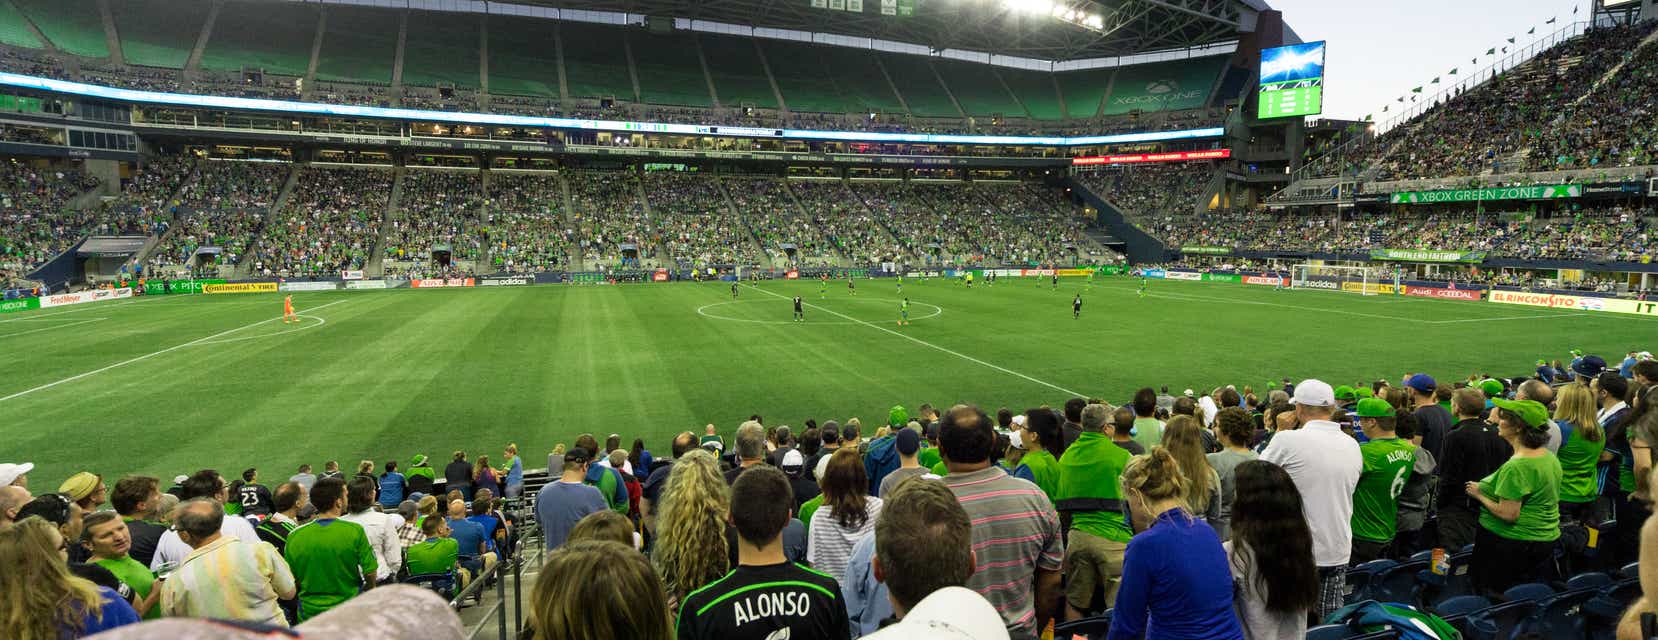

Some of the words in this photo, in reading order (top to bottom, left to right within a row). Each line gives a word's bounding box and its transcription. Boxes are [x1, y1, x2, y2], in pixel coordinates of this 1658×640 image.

[1421, 191, 1452, 202] XBOX
[1454, 189, 1497, 201] GREEN
[1500, 187, 1539, 199] ZONE
[205, 283, 250, 293] Continental
[1308, 280, 1338, 289] adidas
[1412, 287, 1432, 296] Audi
[1494, 293, 1505, 301] EL
[1386, 449, 1413, 464] ALONSO
[1390, 465, 1406, 500] 6
[241, 491, 259, 507] 23
[733, 591, 811, 627] ALONSO
